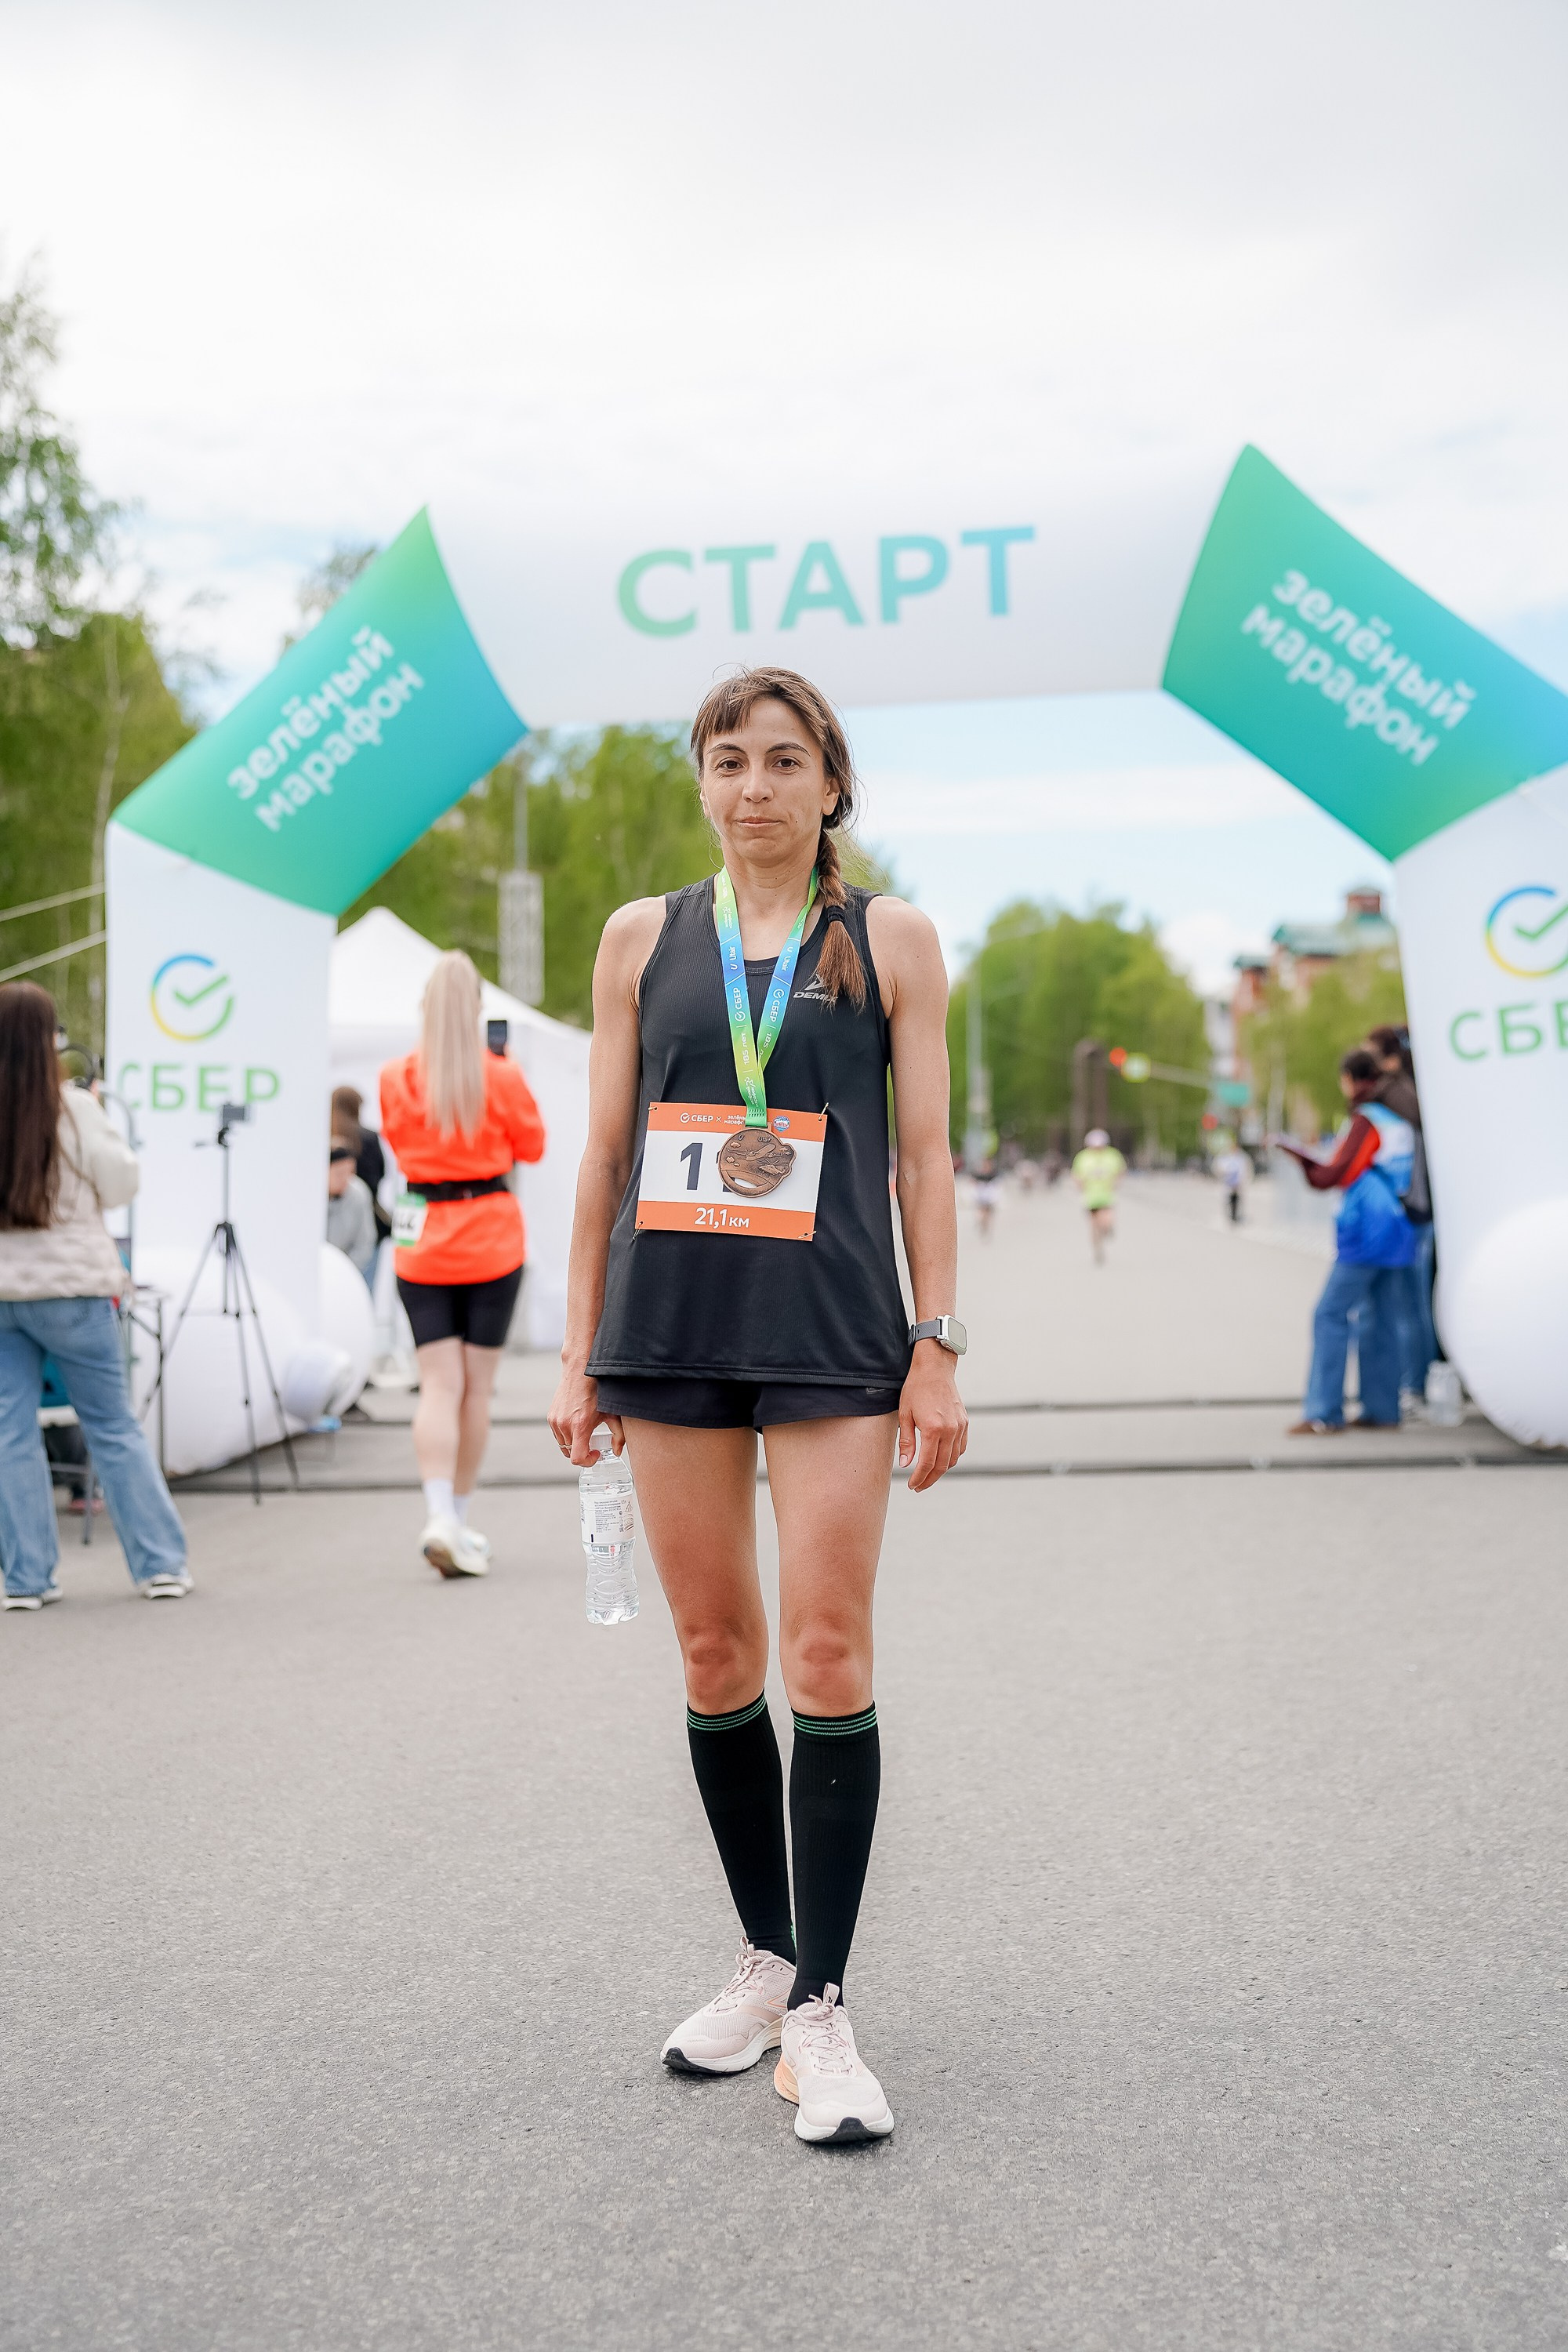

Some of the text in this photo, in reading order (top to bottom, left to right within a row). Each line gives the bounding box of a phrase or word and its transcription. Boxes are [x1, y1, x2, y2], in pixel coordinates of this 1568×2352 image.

[617, 526, 1035, 639] СТАРТ
[1272, 569, 1477, 729] зелёный
[227, 626, 394, 800] зелёный
[1241, 604, 1439, 766] марафон
[256, 662, 423, 832] марафон
[728, 946, 737, 960] Utair
[782, 956, 790, 971] Utair
[733, 988, 742, 1010] СБЕР
[770, 1000, 780, 1022] СБЕР
[695, 1207, 750, 1229] 21,1 км
